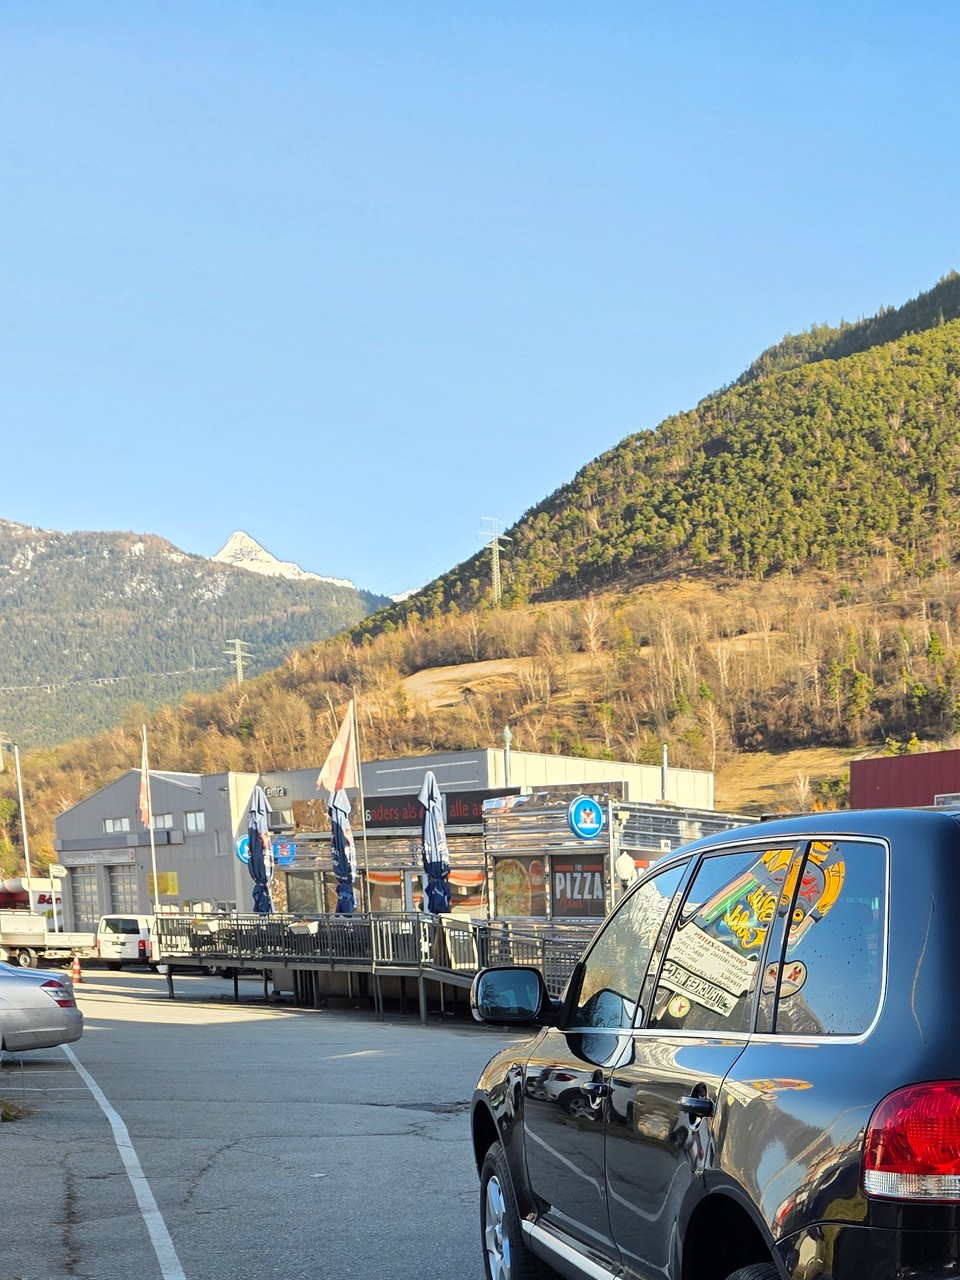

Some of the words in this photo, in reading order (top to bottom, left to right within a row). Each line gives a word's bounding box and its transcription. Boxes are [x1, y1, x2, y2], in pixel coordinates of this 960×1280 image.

[402, 802, 417, 820] als
[450, 799, 469, 817] alle
[555, 872, 603, 900] PIZZA
